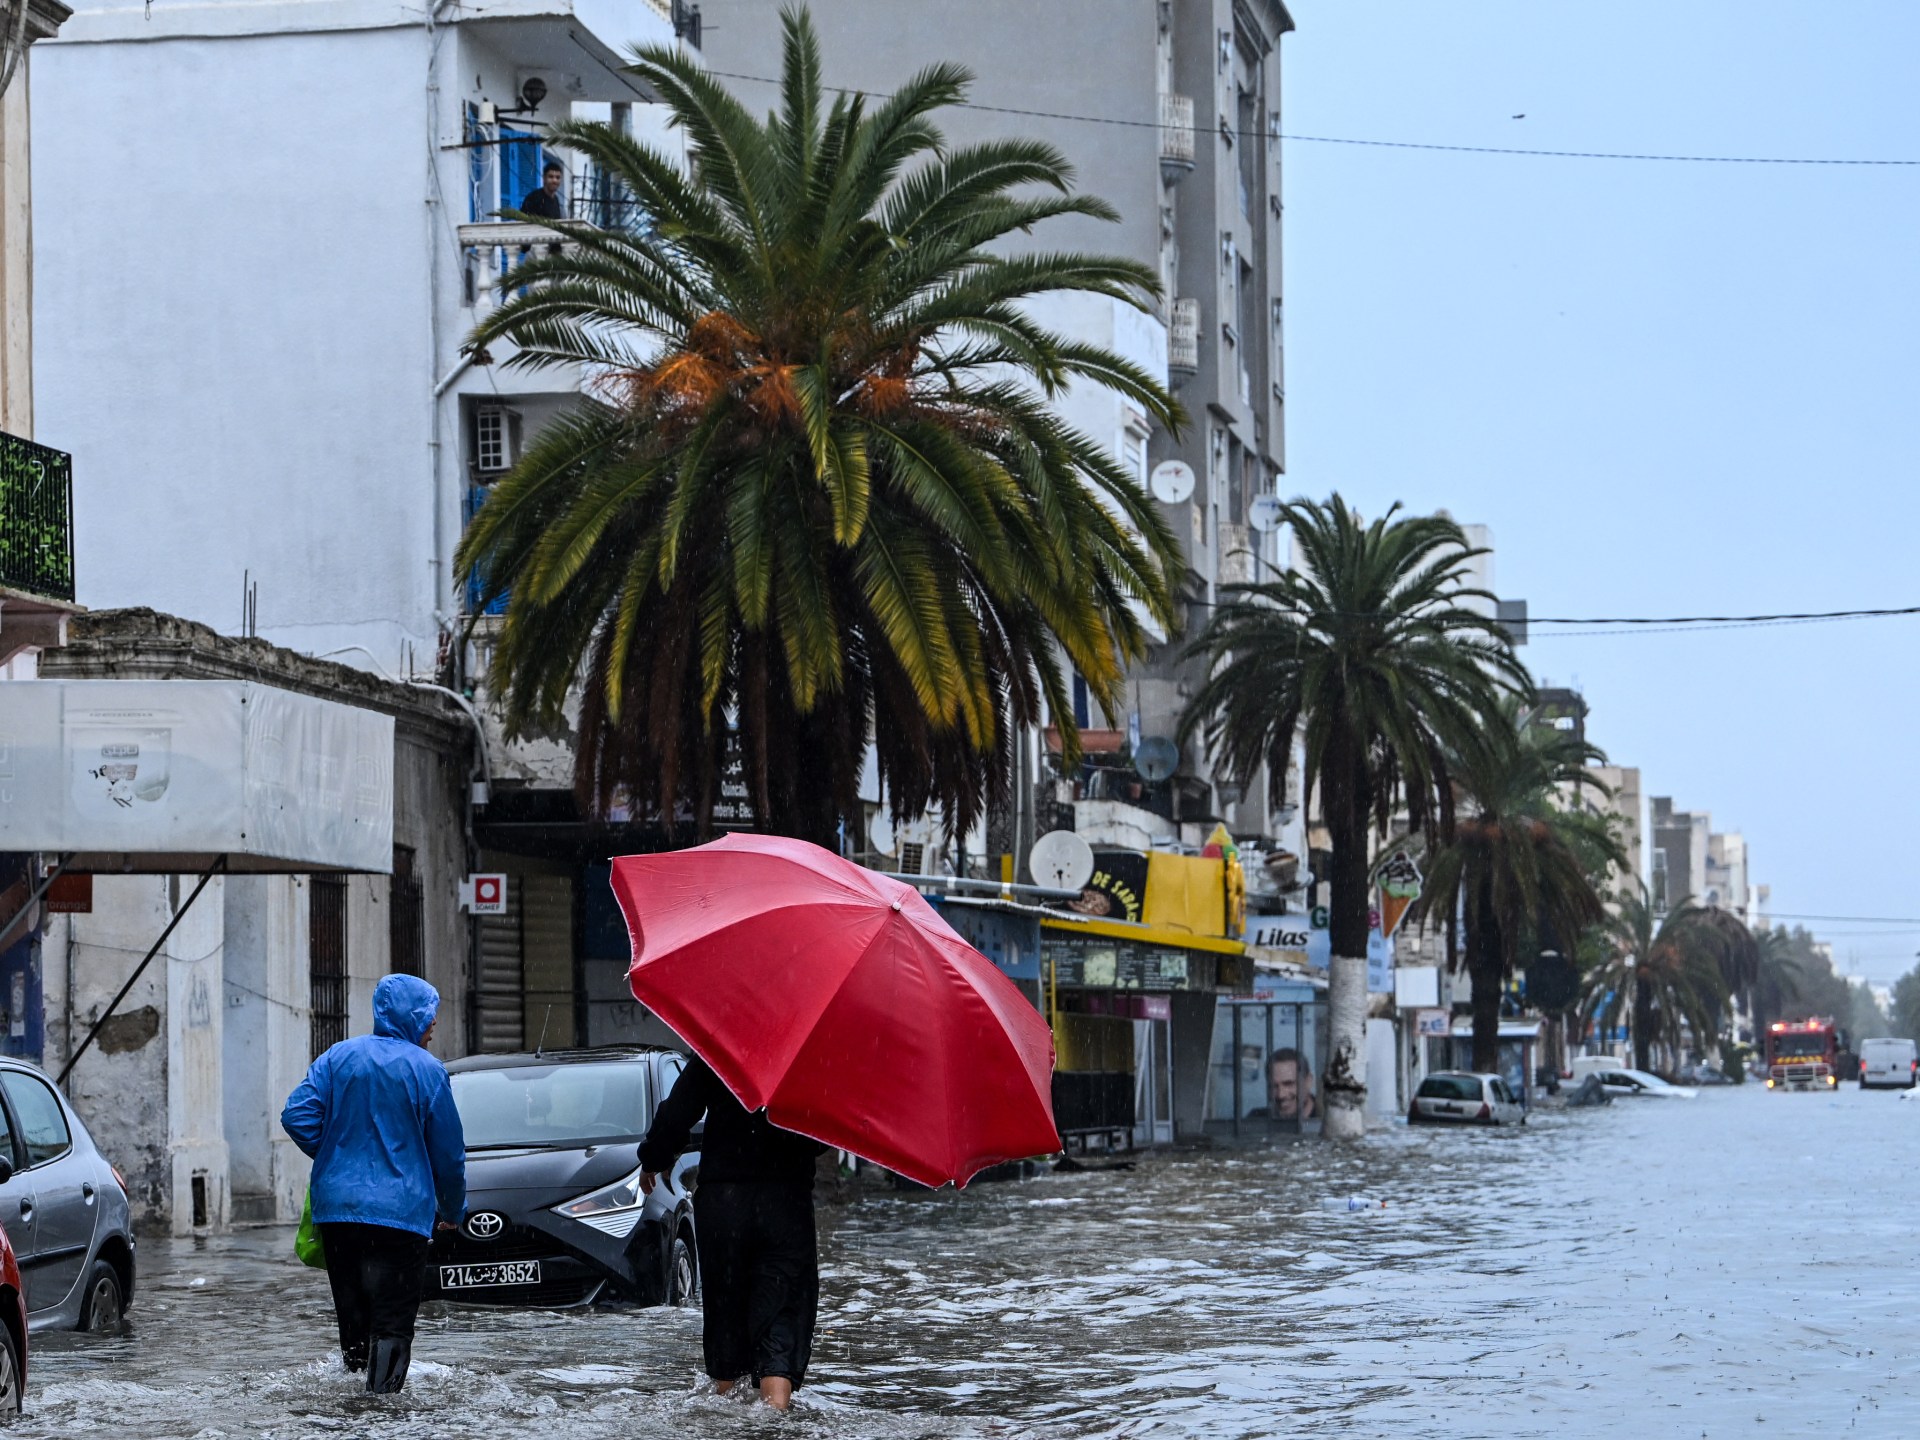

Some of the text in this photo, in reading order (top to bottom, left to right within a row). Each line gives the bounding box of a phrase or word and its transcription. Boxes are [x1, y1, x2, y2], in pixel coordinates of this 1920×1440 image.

[1092, 870, 1111, 888] DE
[49, 901, 87, 911] orange
[1255, 928, 1309, 947] Lilas
[447, 1263, 534, 1287] 214 تونس 3652
